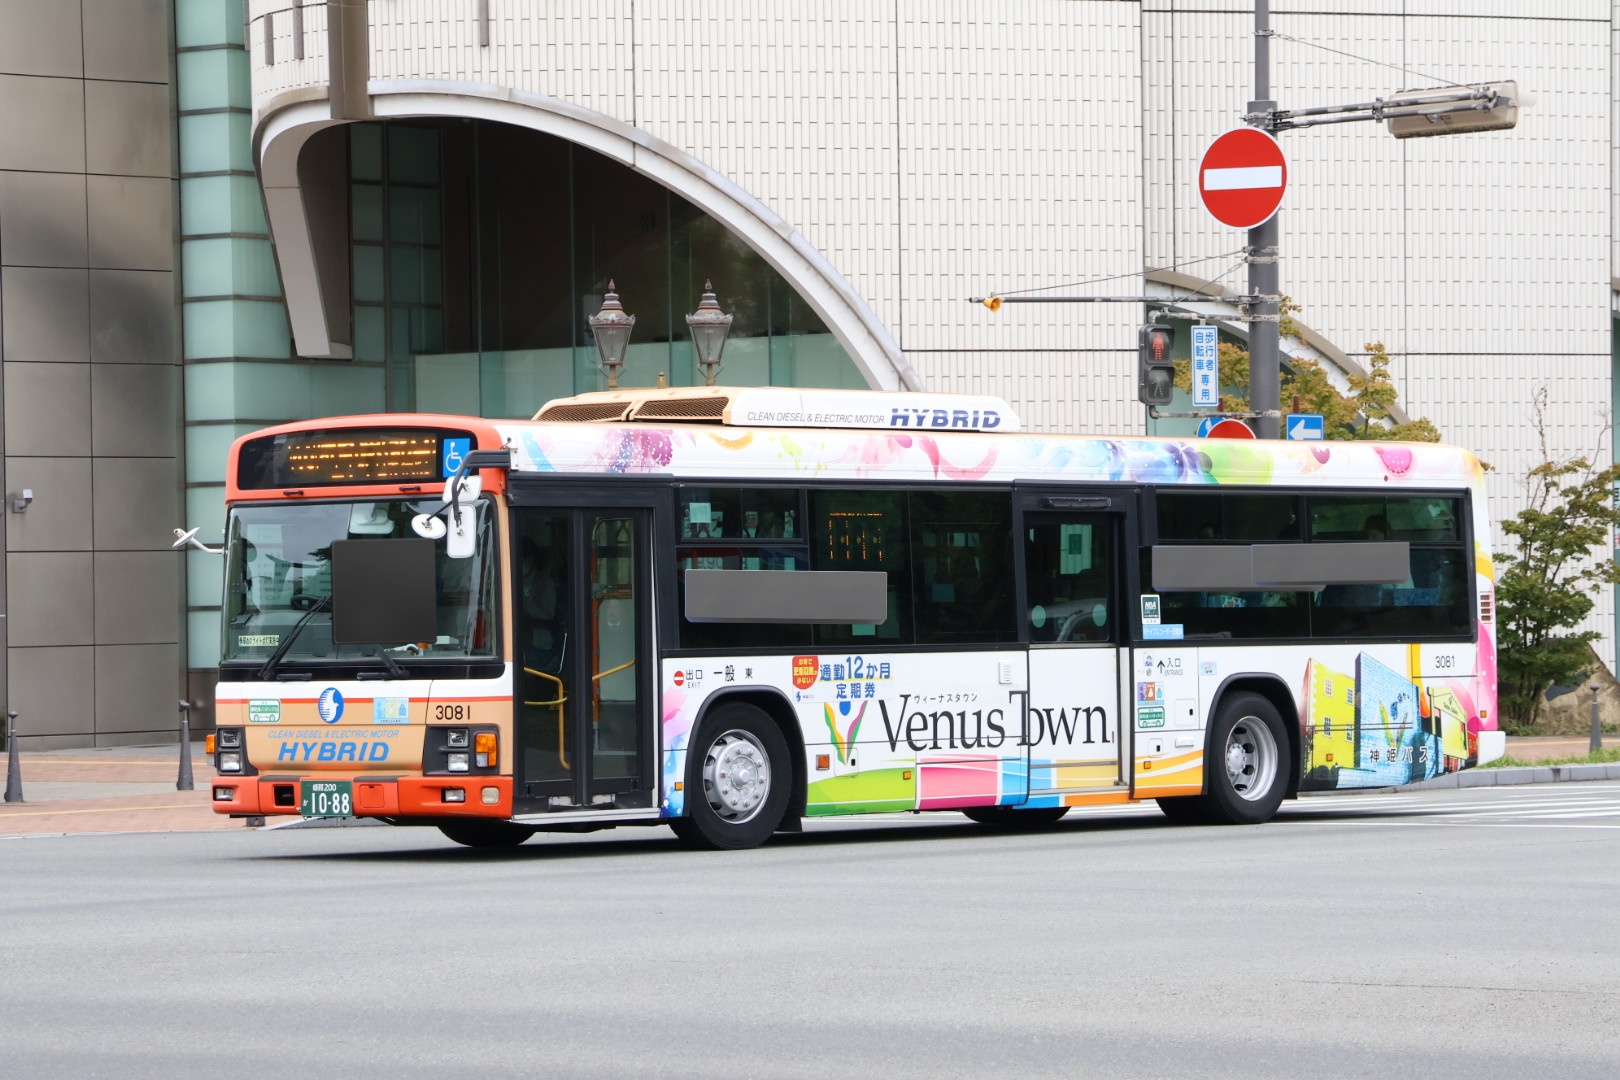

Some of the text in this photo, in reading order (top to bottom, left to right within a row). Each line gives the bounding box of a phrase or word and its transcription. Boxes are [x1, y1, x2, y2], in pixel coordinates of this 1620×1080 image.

[1195, 332, 1204, 370] 自転車
[1205, 332, 1214, 371] 歩行者
[1200, 374, 1210, 401] 専用
[747, 407, 1001, 428] CLEAN DIESEL & ELECTRIC MOTOR HYBRID
[820, 655, 891, 682] 通勤12か月
[1166, 657, 1181, 668] 入口
[1435, 655, 1456, 669] 3081
[685, 664, 753, 682] 出口 一般 東
[687, 681, 701, 689] EXIT
[836, 682, 876, 699] 定期券
[913, 692, 978, 705] ヴィーナスタウン
[435, 704, 471, 721] 3081
[878, 694, 1006, 753] Venus
[268, 729, 294, 739] CLEAN
[295, 729, 322, 739] DIESEL
[331, 729, 368, 739] ELECTRIC
[370, 729, 400, 739] MOTOR
[278, 741, 390, 762] HYBRID
[1369, 746, 1430, 764] 神姫バス
[311, 792, 350, 814] 10-88
